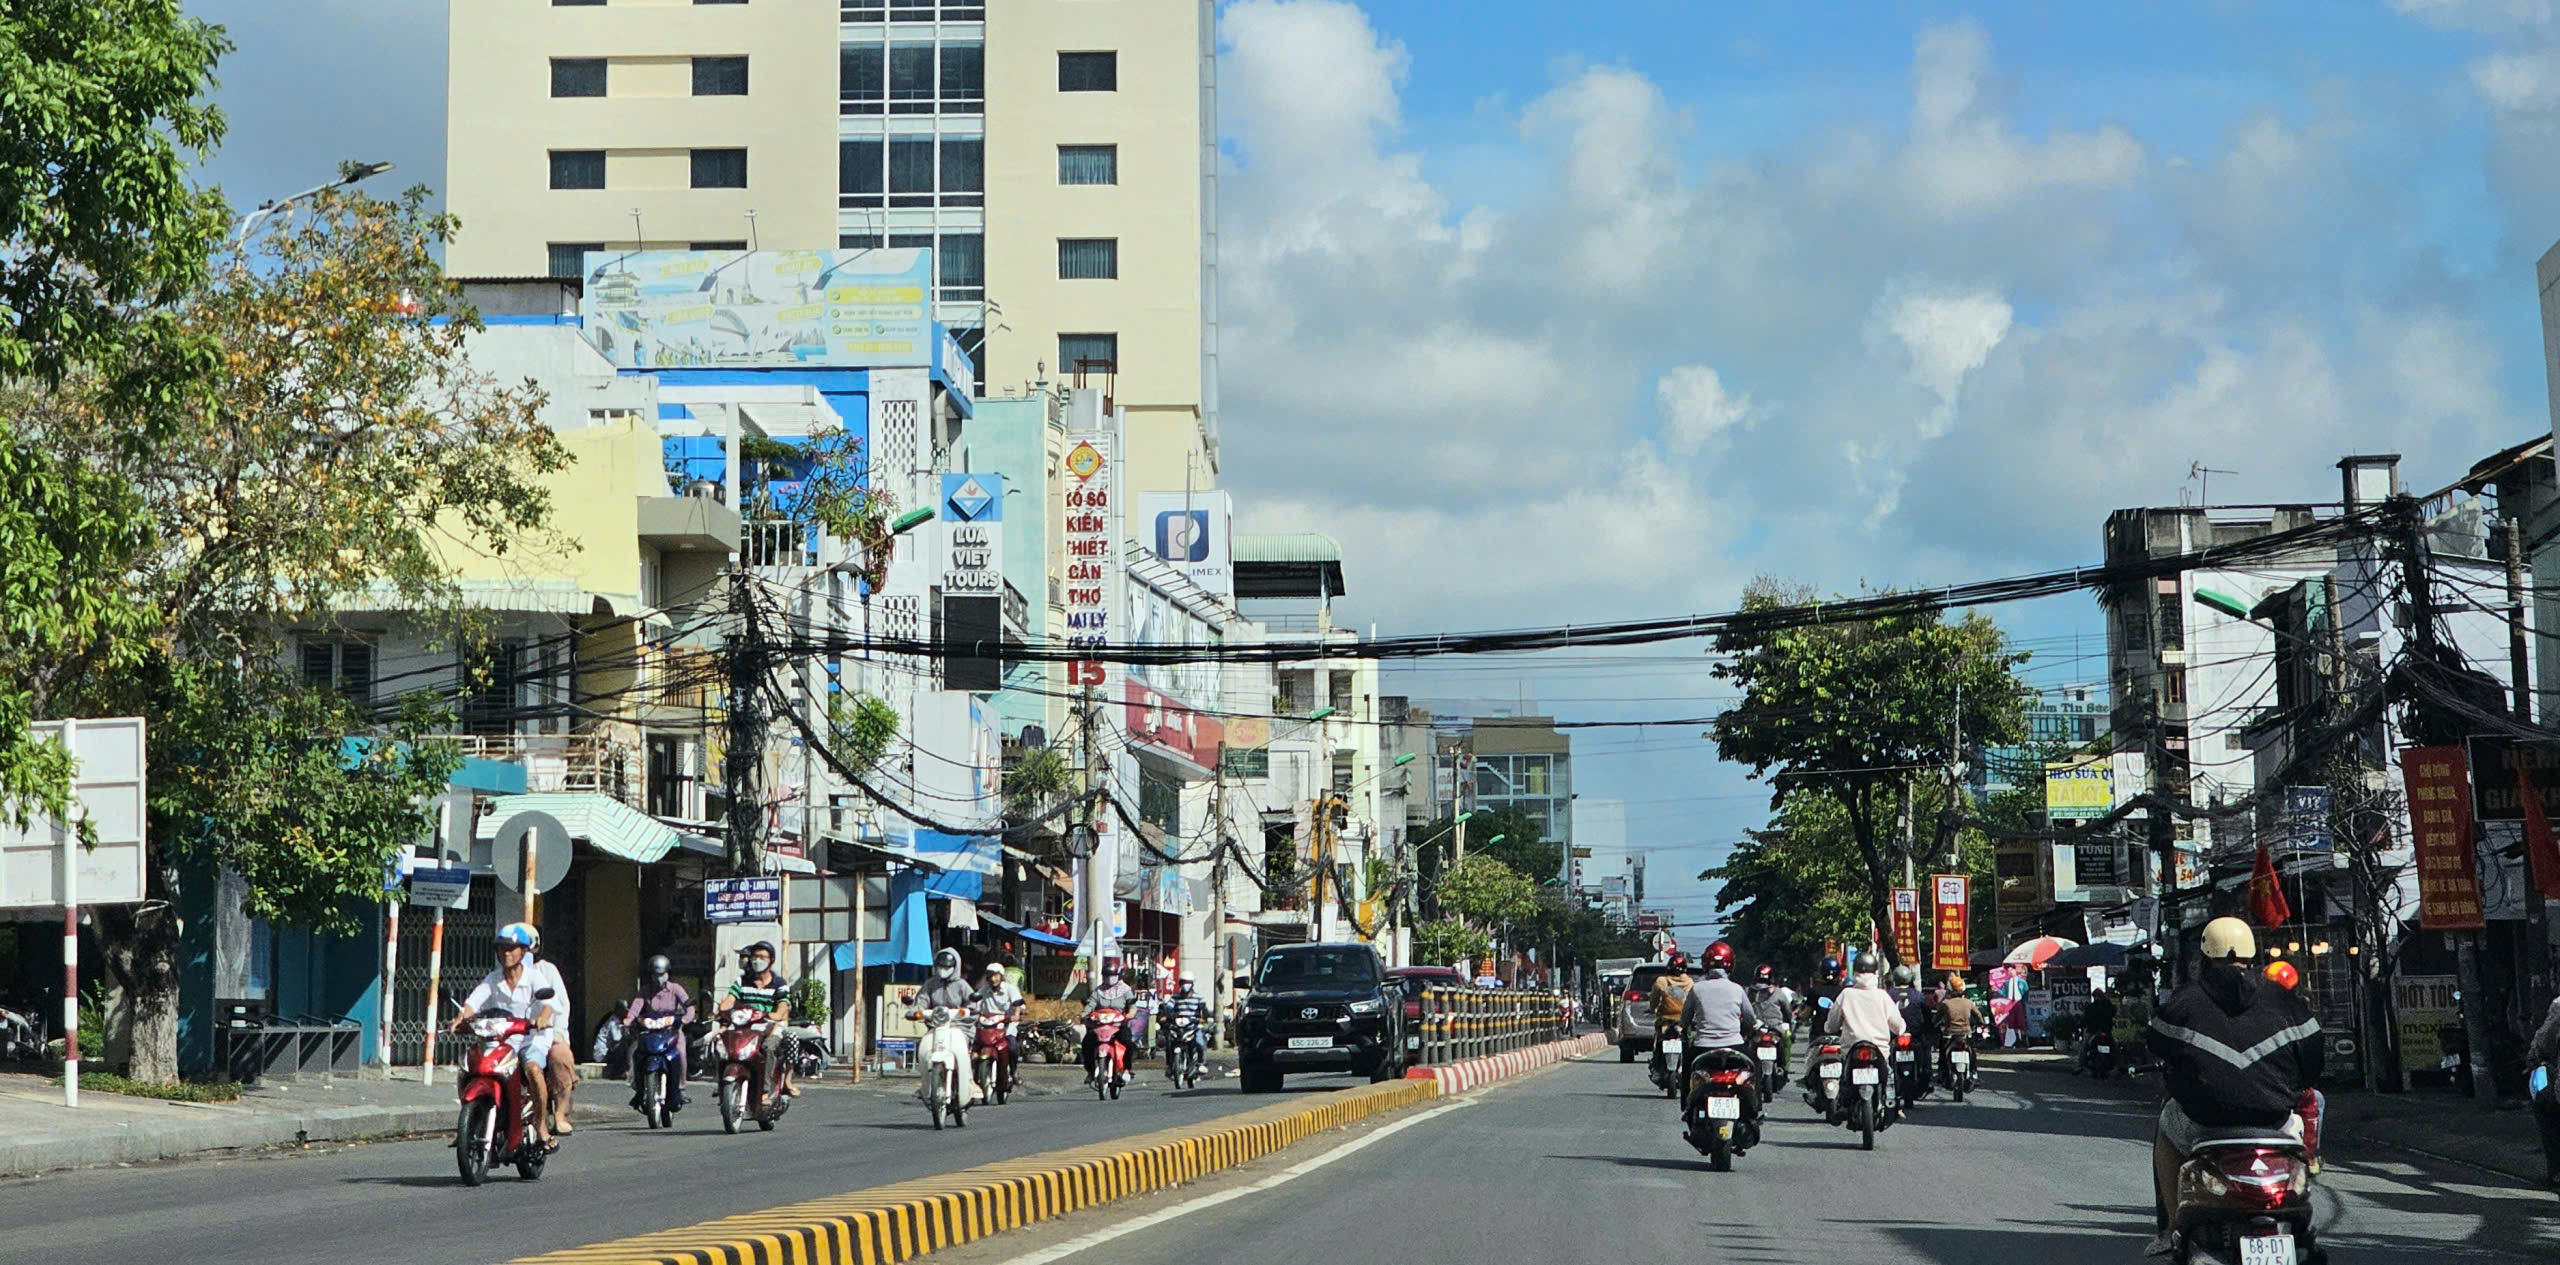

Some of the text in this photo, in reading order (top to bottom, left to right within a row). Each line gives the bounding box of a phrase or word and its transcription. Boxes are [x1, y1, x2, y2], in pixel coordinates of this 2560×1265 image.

[1087, 485, 1107, 507] SỐ
[1067, 511, 1103, 533] KIẾN
[944, 571, 999, 591] TOURS
[1068, 660, 1106, 685] 15
[2061, 702, 2083, 712] Tin
